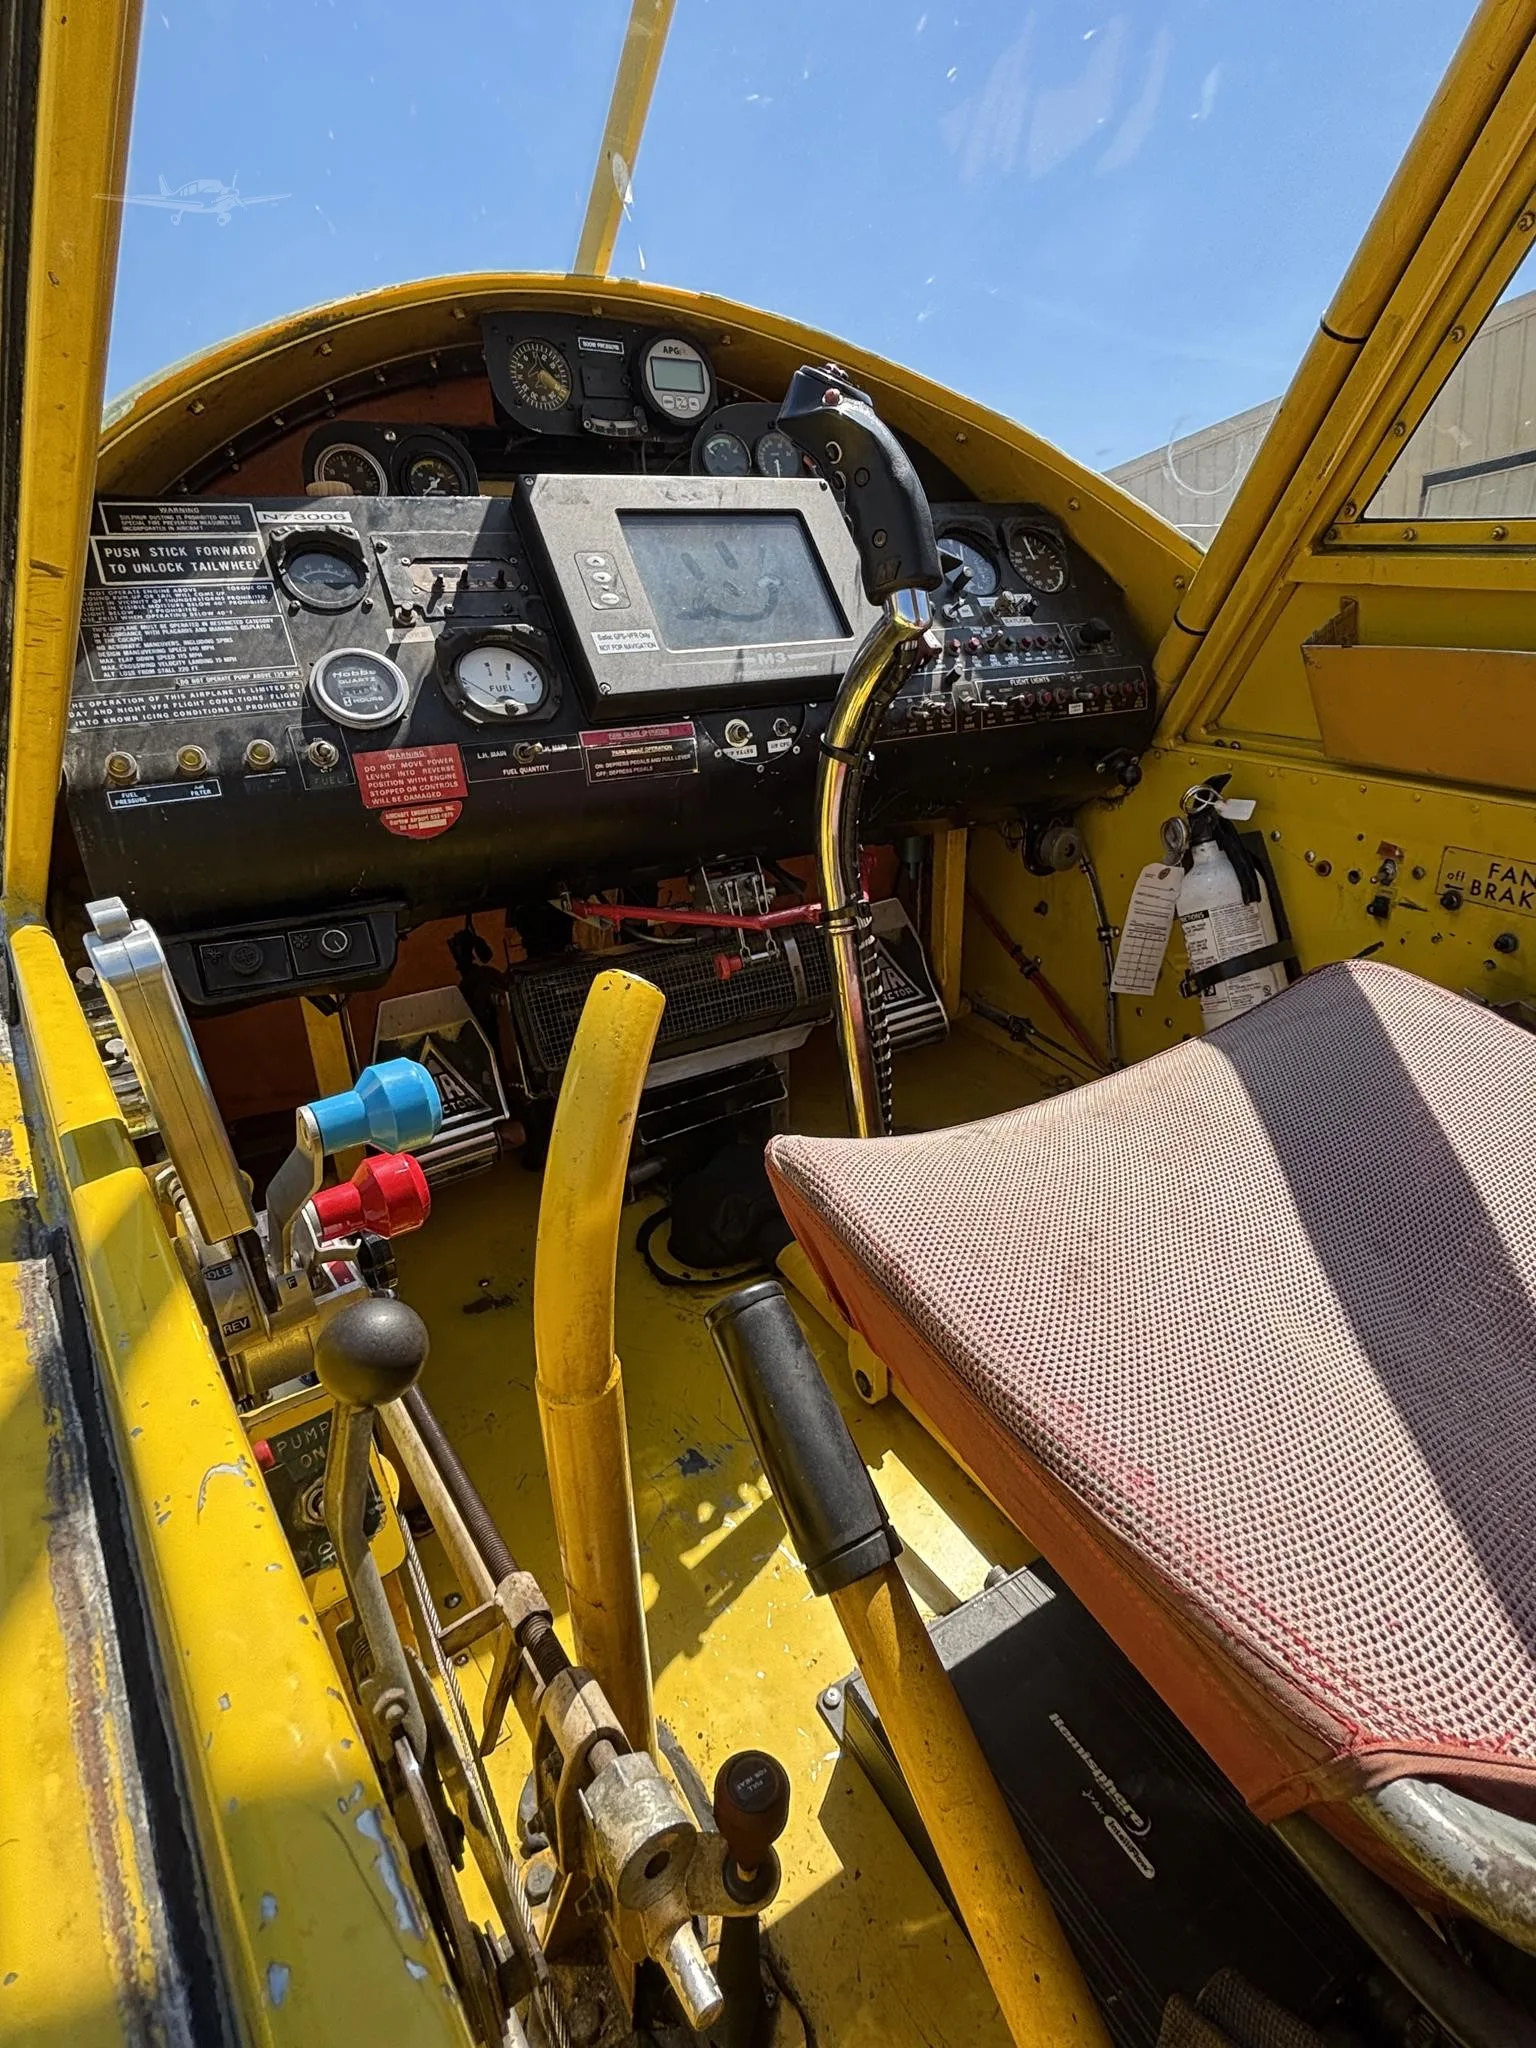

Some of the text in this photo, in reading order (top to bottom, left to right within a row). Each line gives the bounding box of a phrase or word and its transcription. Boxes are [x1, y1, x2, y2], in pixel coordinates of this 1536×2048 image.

[663, 346, 680, 354] APG
[105, 545, 256, 558] PUSH STICK FORWARD
[109, 560, 259, 574] TO UNLOCK TAILWHEEL
[758, 652, 788, 664] M3
[489, 684, 515, 692] FUEL
[90, 696, 145, 708] OPERATION
[190, 690, 234, 698] AIRPLANE
[250, 685, 286, 693] LIMITED
[68, 710, 88, 718] DAY
[93, 708, 113, 716] AND
[117, 704, 146, 714] NIGHT
[172, 699, 205, 708] FLIGHT
[270, 692, 300, 700] FLIGHT
[76, 718, 99, 727] INTO
[103, 715, 138, 724] KNOWN
[142, 712, 169, 720] ICING
[174, 706, 230, 718] CONDITIONS
[388, 750, 424, 759] WARNING
[644, 745, 672, 753] OPERATION
[423, 766, 455, 774] REVERSE
[520, 764, 550, 774] QUANTITY
[368, 780, 404, 788] POSITION
[430, 774, 456, 782] ENGINE
[370, 788, 404, 798] STOPPED
[420, 781, 458, 790] CONTROLS
[404, 792, 441, 801] DAMAGED
[114, 796, 148, 806] PRESSURE
[1447, 870, 1465, 880] off
[1488, 862, 1536, 890] FAN
[1470, 879, 1536, 909] BRAK
[288, 1278, 295, 1286] F
[224, 1318, 248, 1334] REV
[276, 1421, 329, 1453] PUMP
[300, 1446, 326, 1468] ON
[318, 1541, 338, 1563] OF
[1048, 1712, 1144, 1828] Hemisphere
